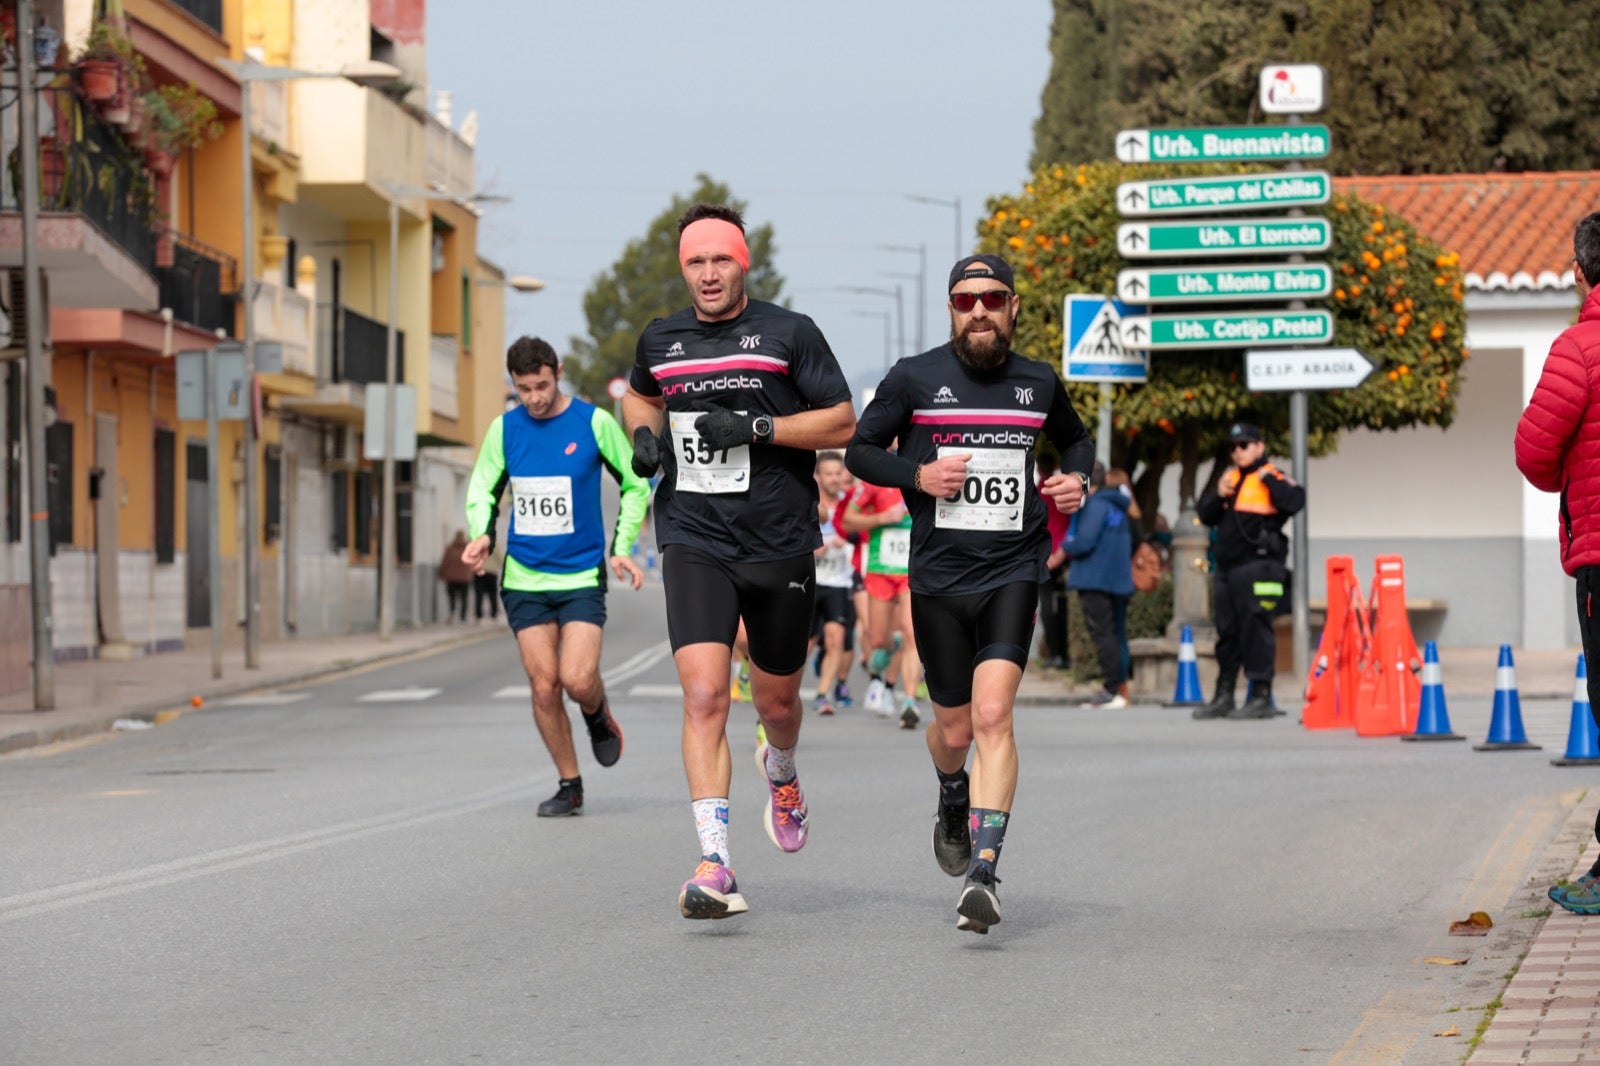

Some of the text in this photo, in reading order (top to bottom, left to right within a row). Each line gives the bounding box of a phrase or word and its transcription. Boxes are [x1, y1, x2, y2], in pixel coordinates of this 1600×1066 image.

[1153, 132, 1325, 157] Urb. Buenavista
[1151, 179, 1322, 205] Urb. Parque del Cubillas
[1199, 224, 1322, 246] Urb. El torreón
[1177, 271, 1322, 293] Urb. Monte Elvira
[1173, 316, 1323, 340] Urb. Cortijo Pretel
[662, 376, 762, 396] runrundata
[932, 430, 1034, 446] runrundata
[518, 497, 567, 516] 3166
